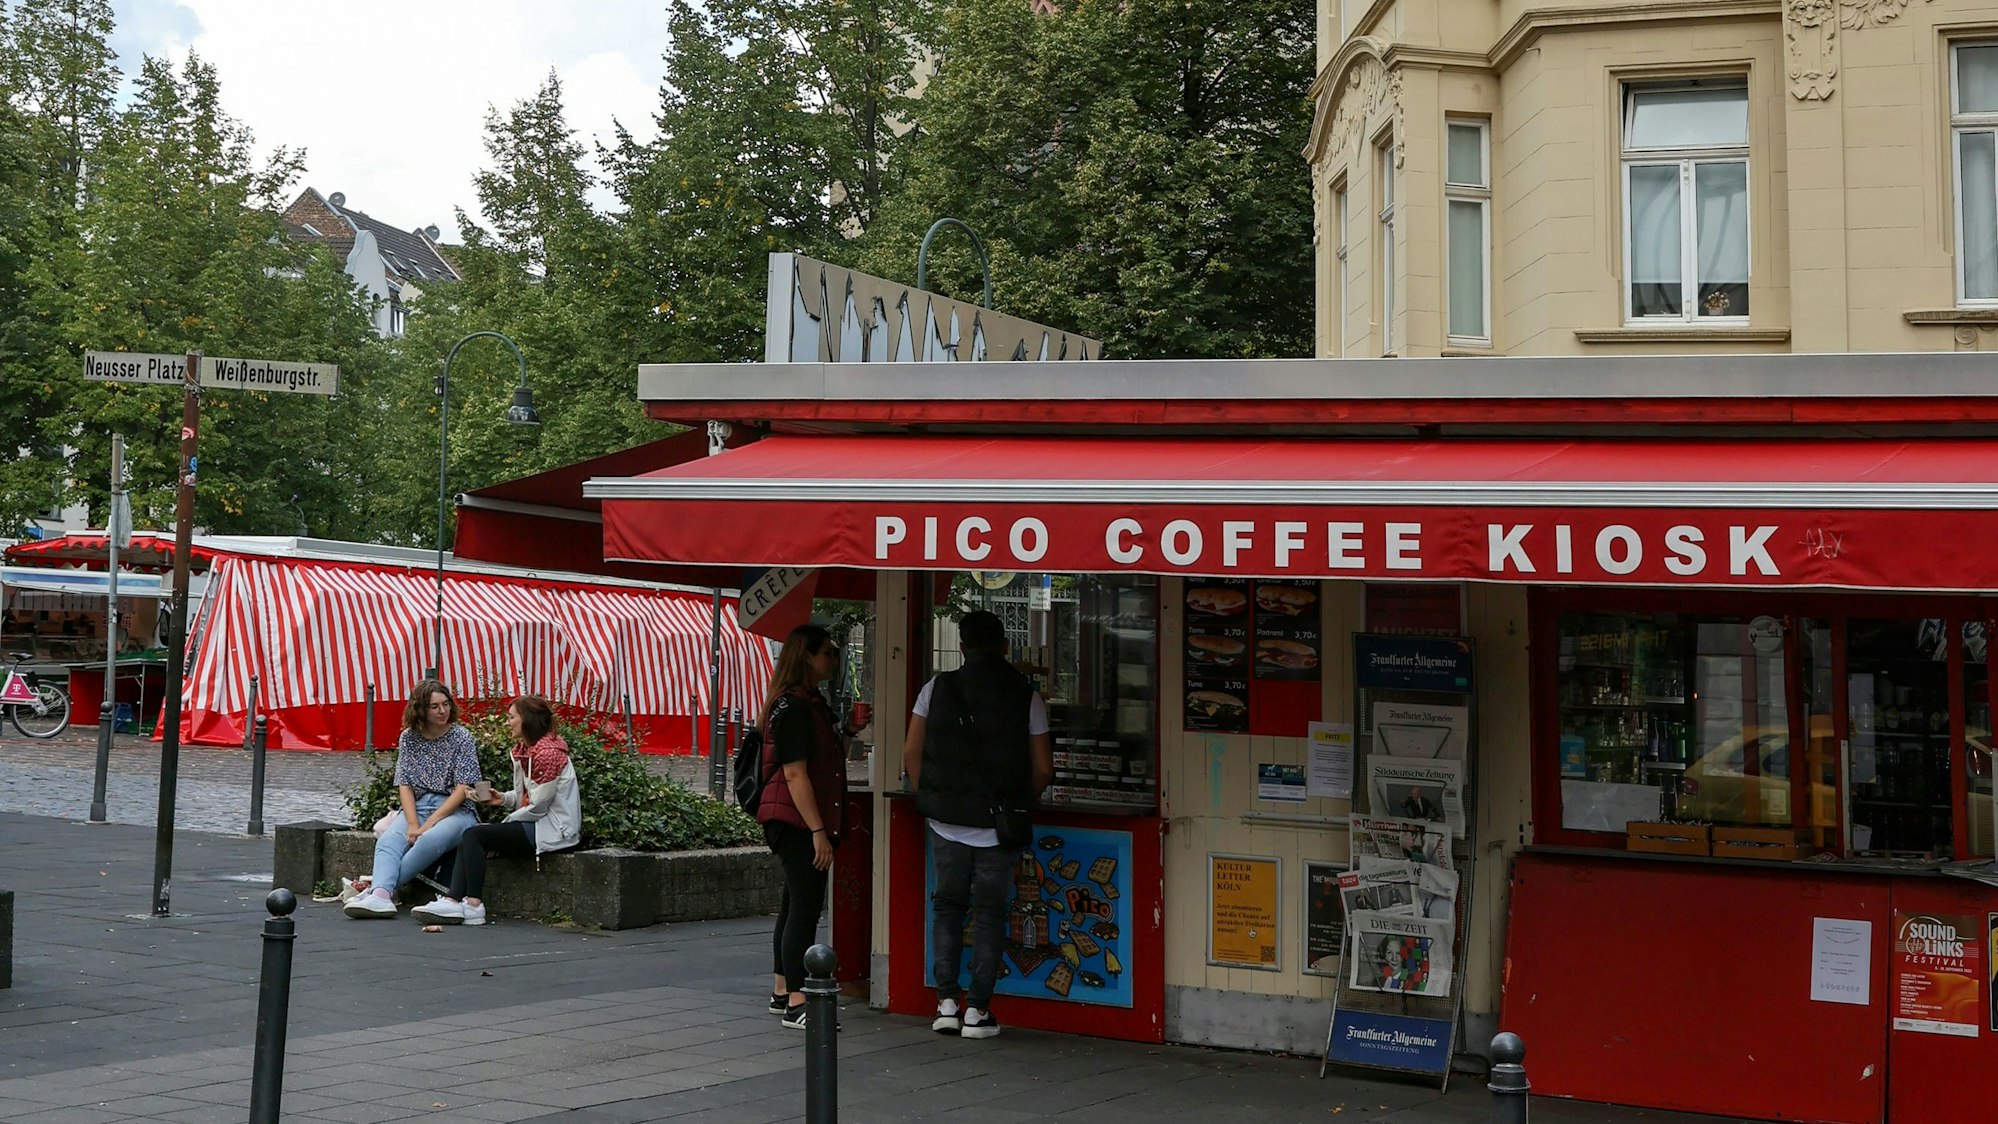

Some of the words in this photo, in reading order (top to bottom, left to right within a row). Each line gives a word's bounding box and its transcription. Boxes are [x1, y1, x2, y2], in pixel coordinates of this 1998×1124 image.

[85, 355, 141, 378] Neusser
[147, 357, 184, 380] Platz
[214, 359, 322, 391] Weißenburgstr.
[875, 516, 1049, 563] PICO
[1105, 517, 1422, 570] COFFEE
[1487, 523, 1781, 576] KIOSK
[1370, 652, 1414, 668] Frankfurter
[1414, 651, 1457, 669] Allgemeine
[1374, 766, 1424, 778] Süddeutsche
[1424, 768, 1455, 780] Zeitung
[1216, 862, 1253, 872] KULTUR
[1216, 872, 1251, 882] LETTER
[1216, 880, 1242, 892] KÖLN
[1066, 887, 1113, 920] Pico
[1370, 919, 1391, 931] DIE
[1403, 923, 1427, 935] ZEIT
[1909, 922, 1956, 942] SOUND
[1905, 955, 1965, 968] FESTIVAL
[1346, 1025, 1392, 1043] Frankfurter
[1391, 1029, 1437, 1048] Allgemeine
[1360, 1041, 1420, 1055] SONNTAGSZEITUNG
